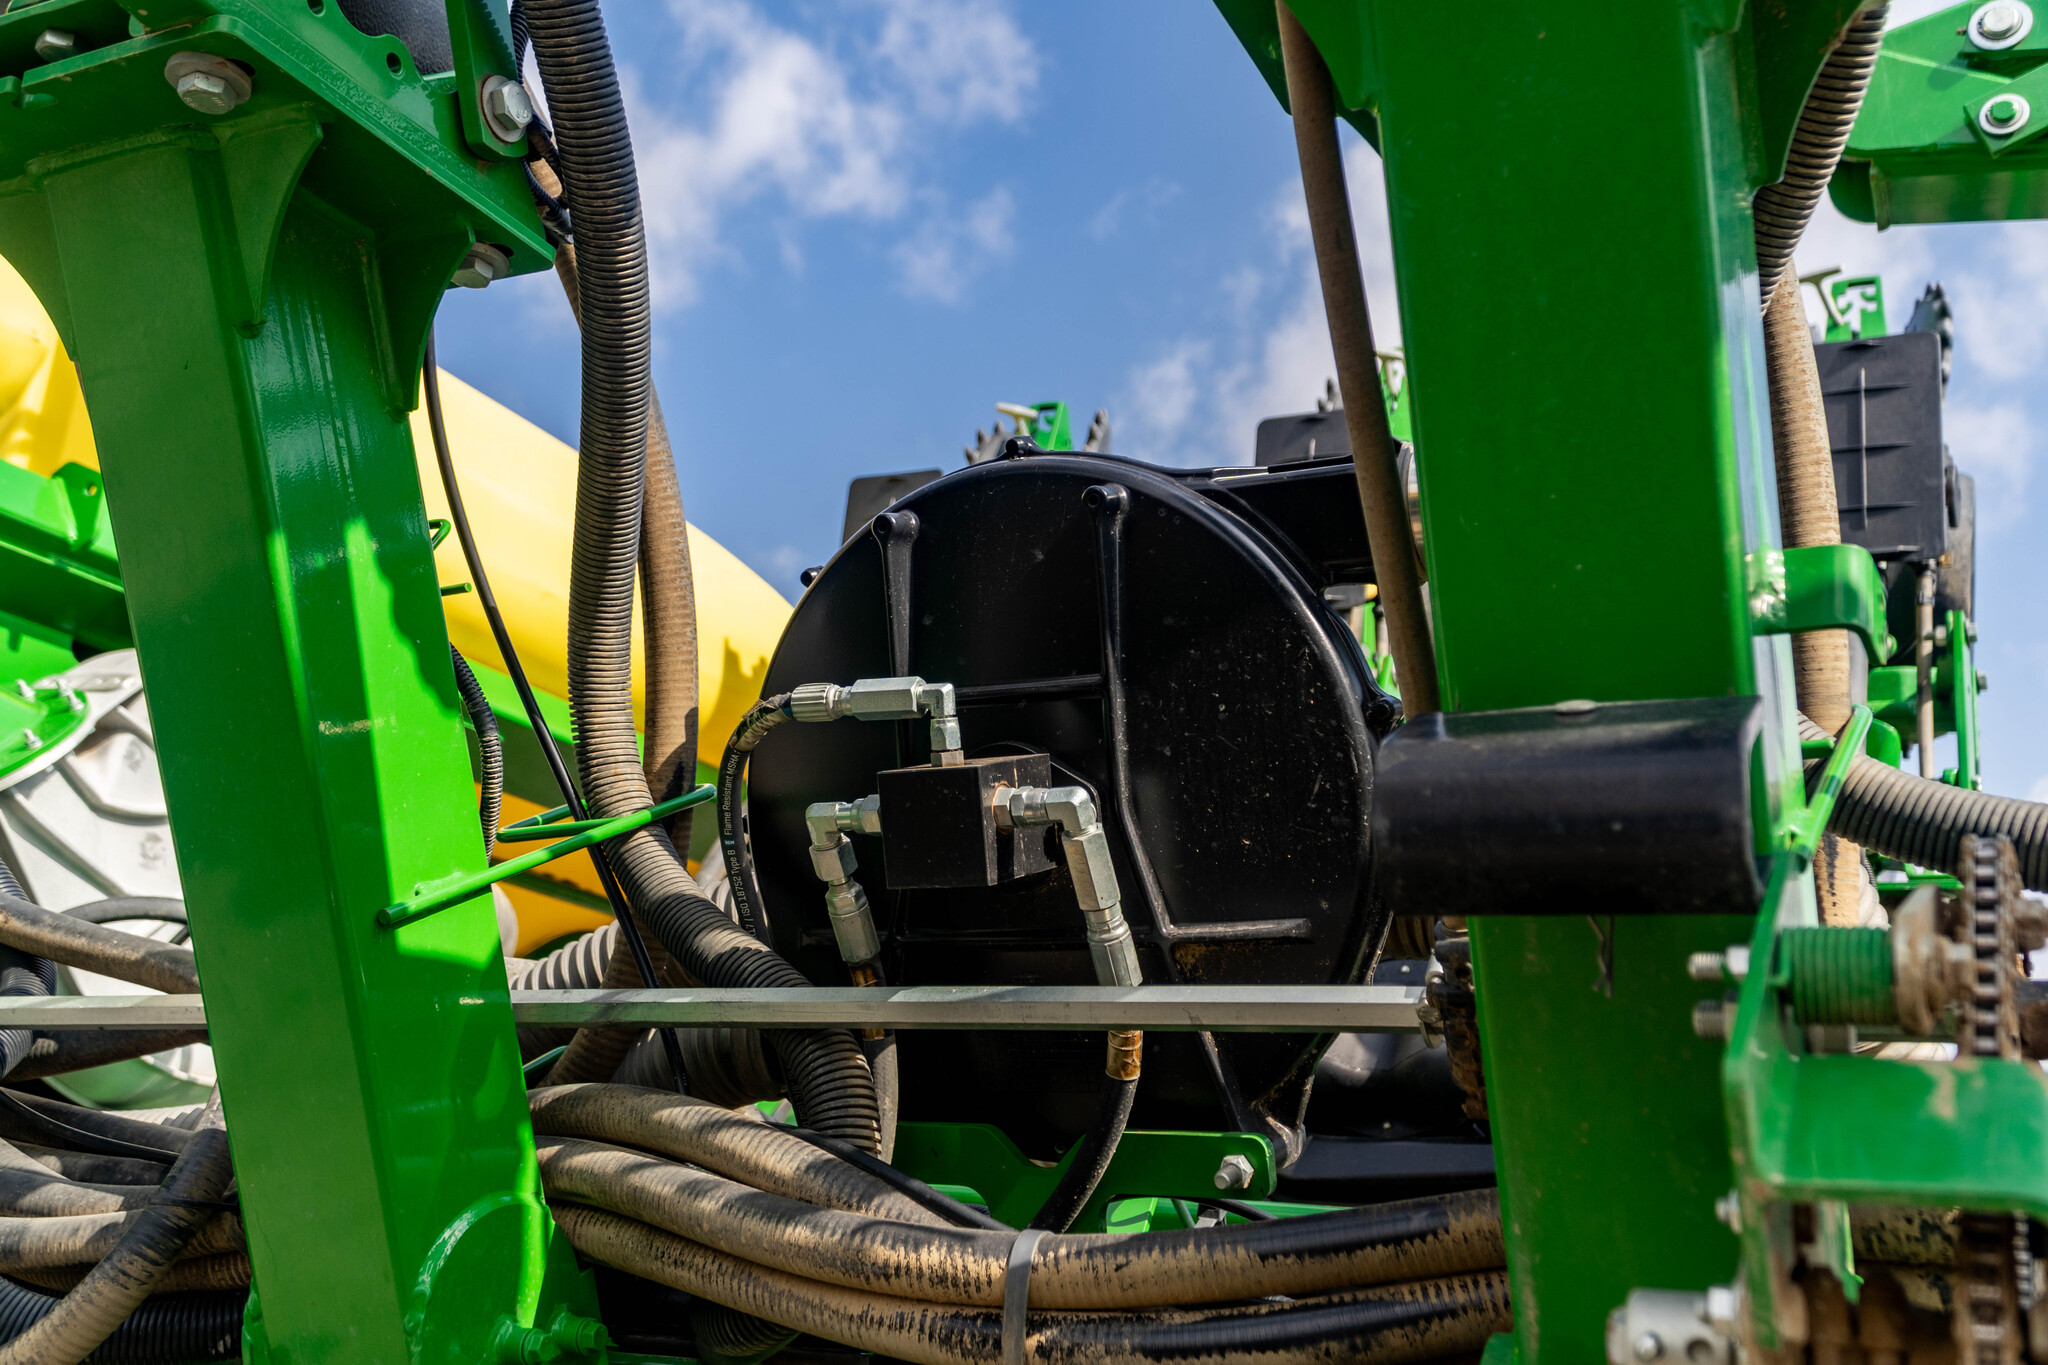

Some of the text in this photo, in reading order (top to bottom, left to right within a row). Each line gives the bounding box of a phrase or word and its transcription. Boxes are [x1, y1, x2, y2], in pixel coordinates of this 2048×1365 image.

[726, 753, 741, 775] MSHA
[722, 775, 734, 811] Resistant
[724, 811, 733, 836] Flame
[730, 856, 741, 875] Type
[733, 875, 747, 901] 18752
[740, 903, 751, 917] ISO
